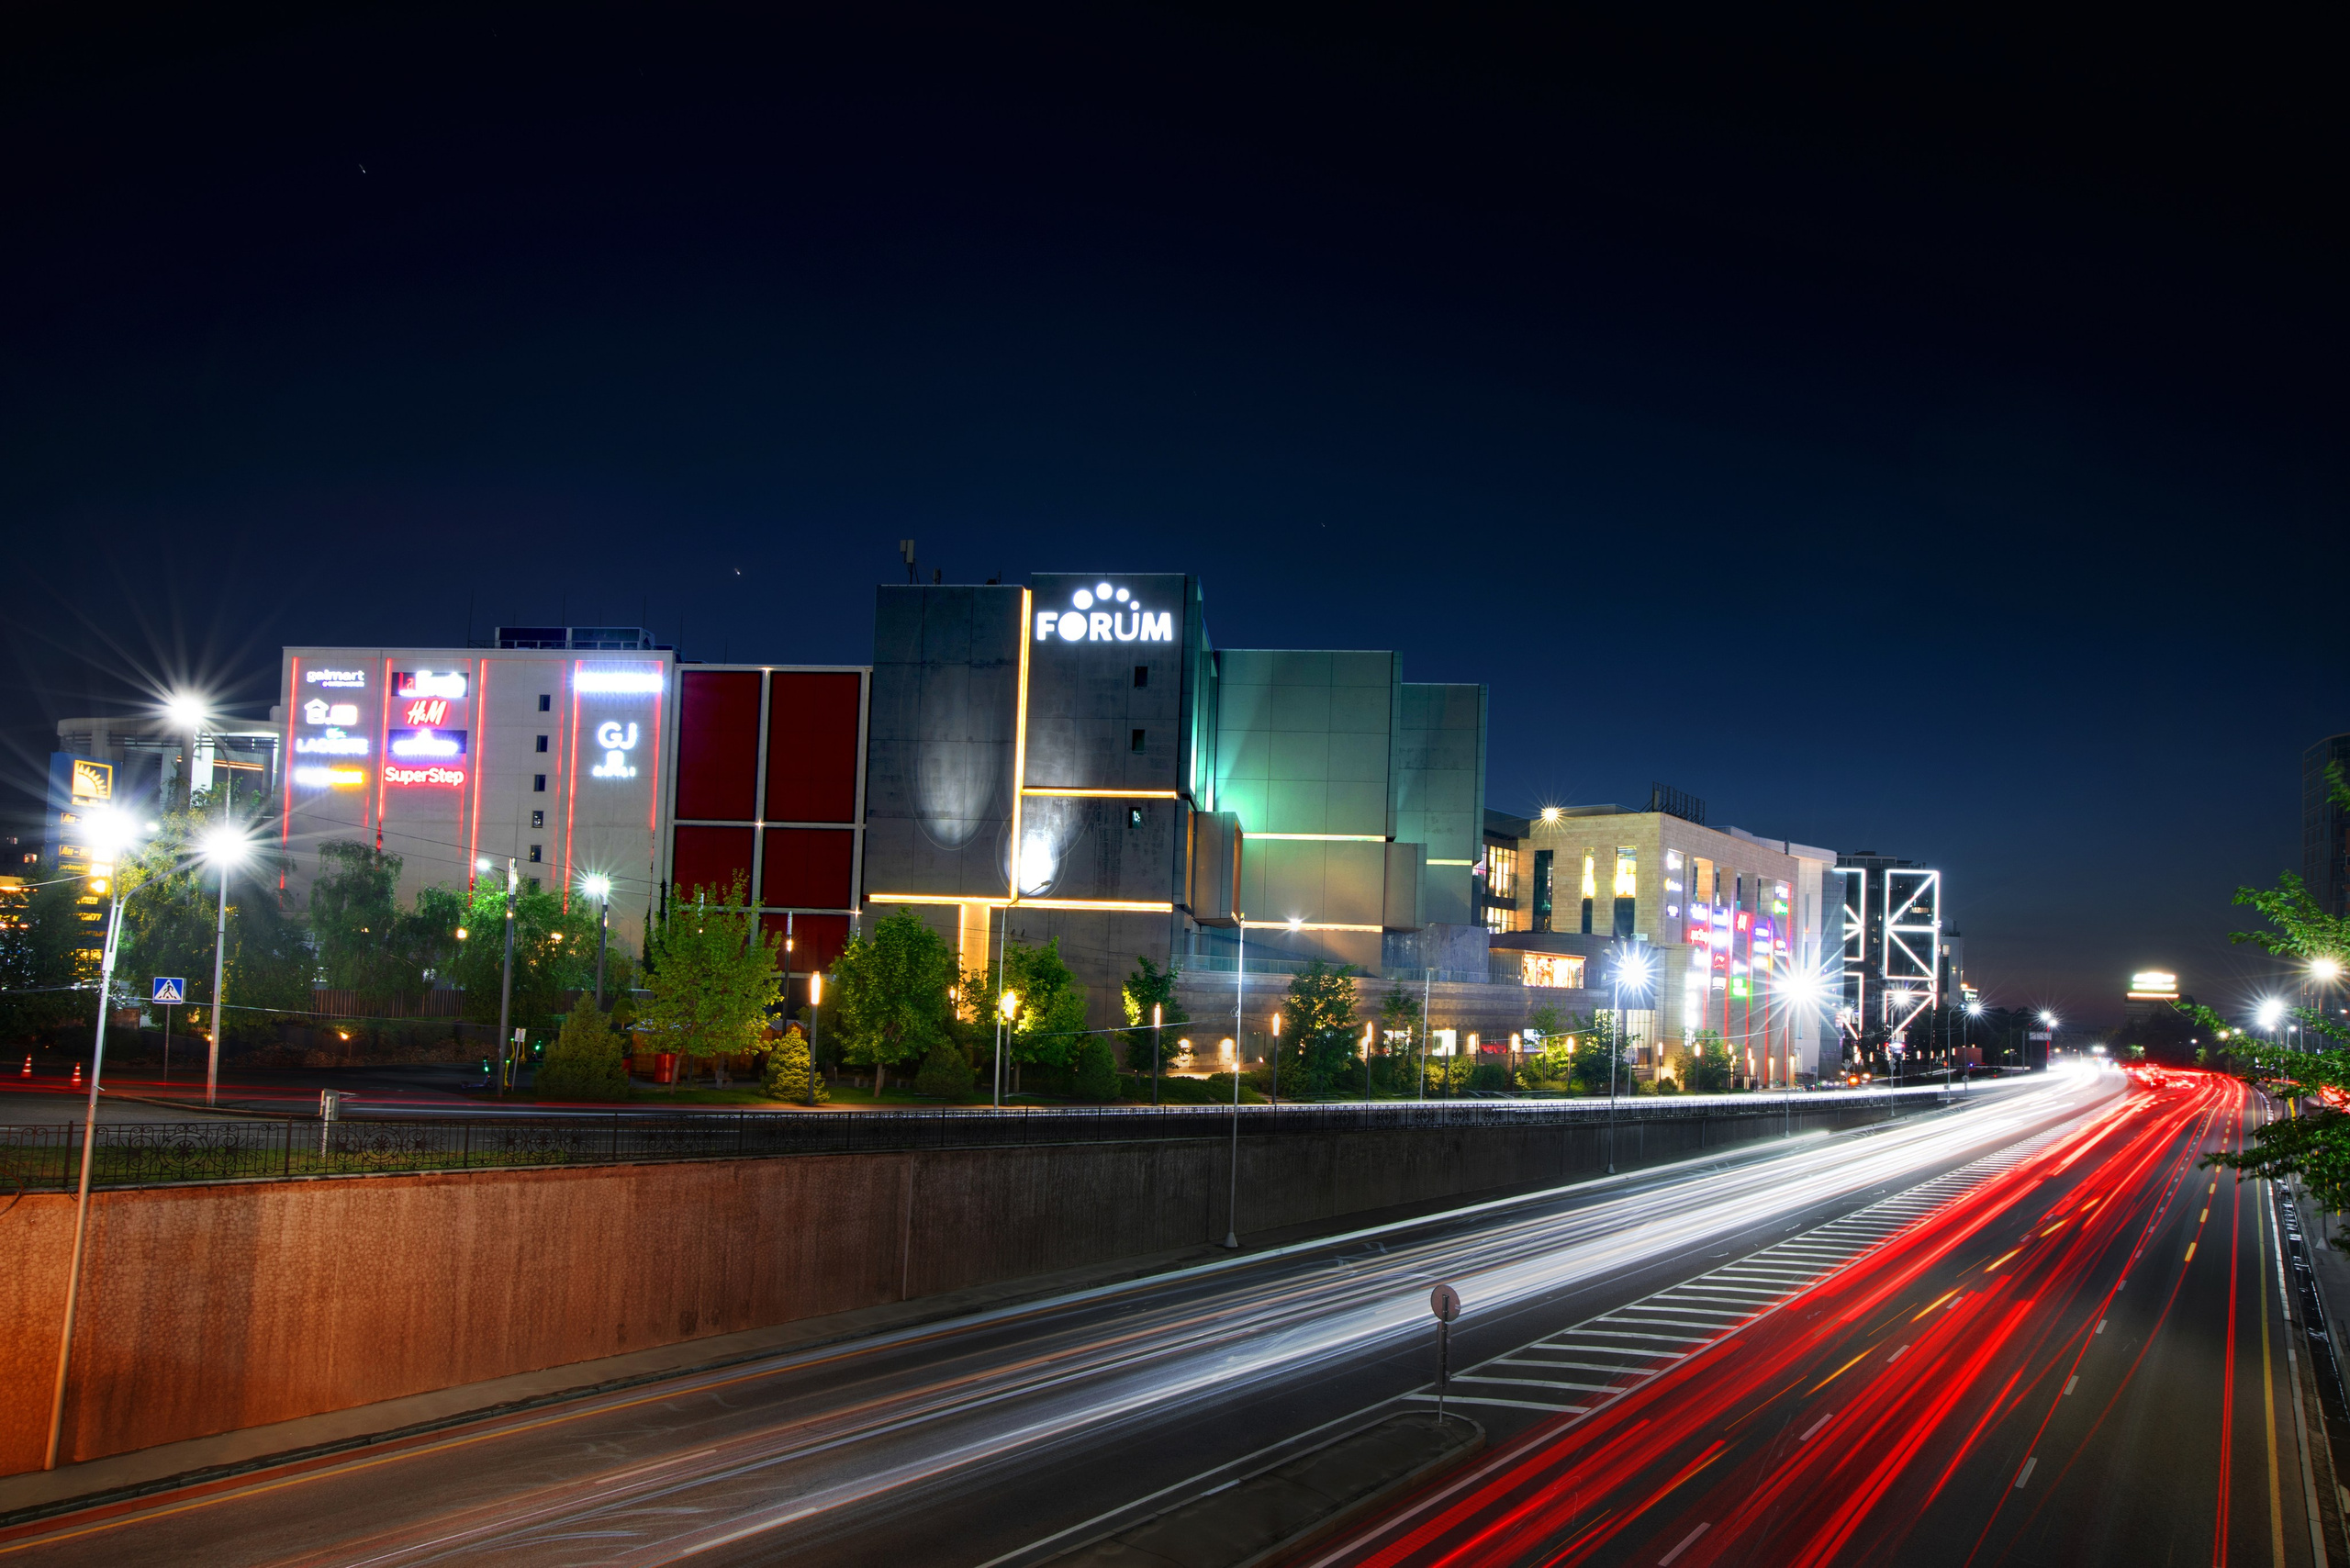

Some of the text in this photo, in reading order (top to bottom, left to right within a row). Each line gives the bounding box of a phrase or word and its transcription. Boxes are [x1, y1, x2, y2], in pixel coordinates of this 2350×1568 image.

[1036, 611, 1173, 642] FORUM
[407, 700, 448, 726] H&M
[598, 721, 638, 750] GJ
[385, 766, 464, 787] SuperStep
